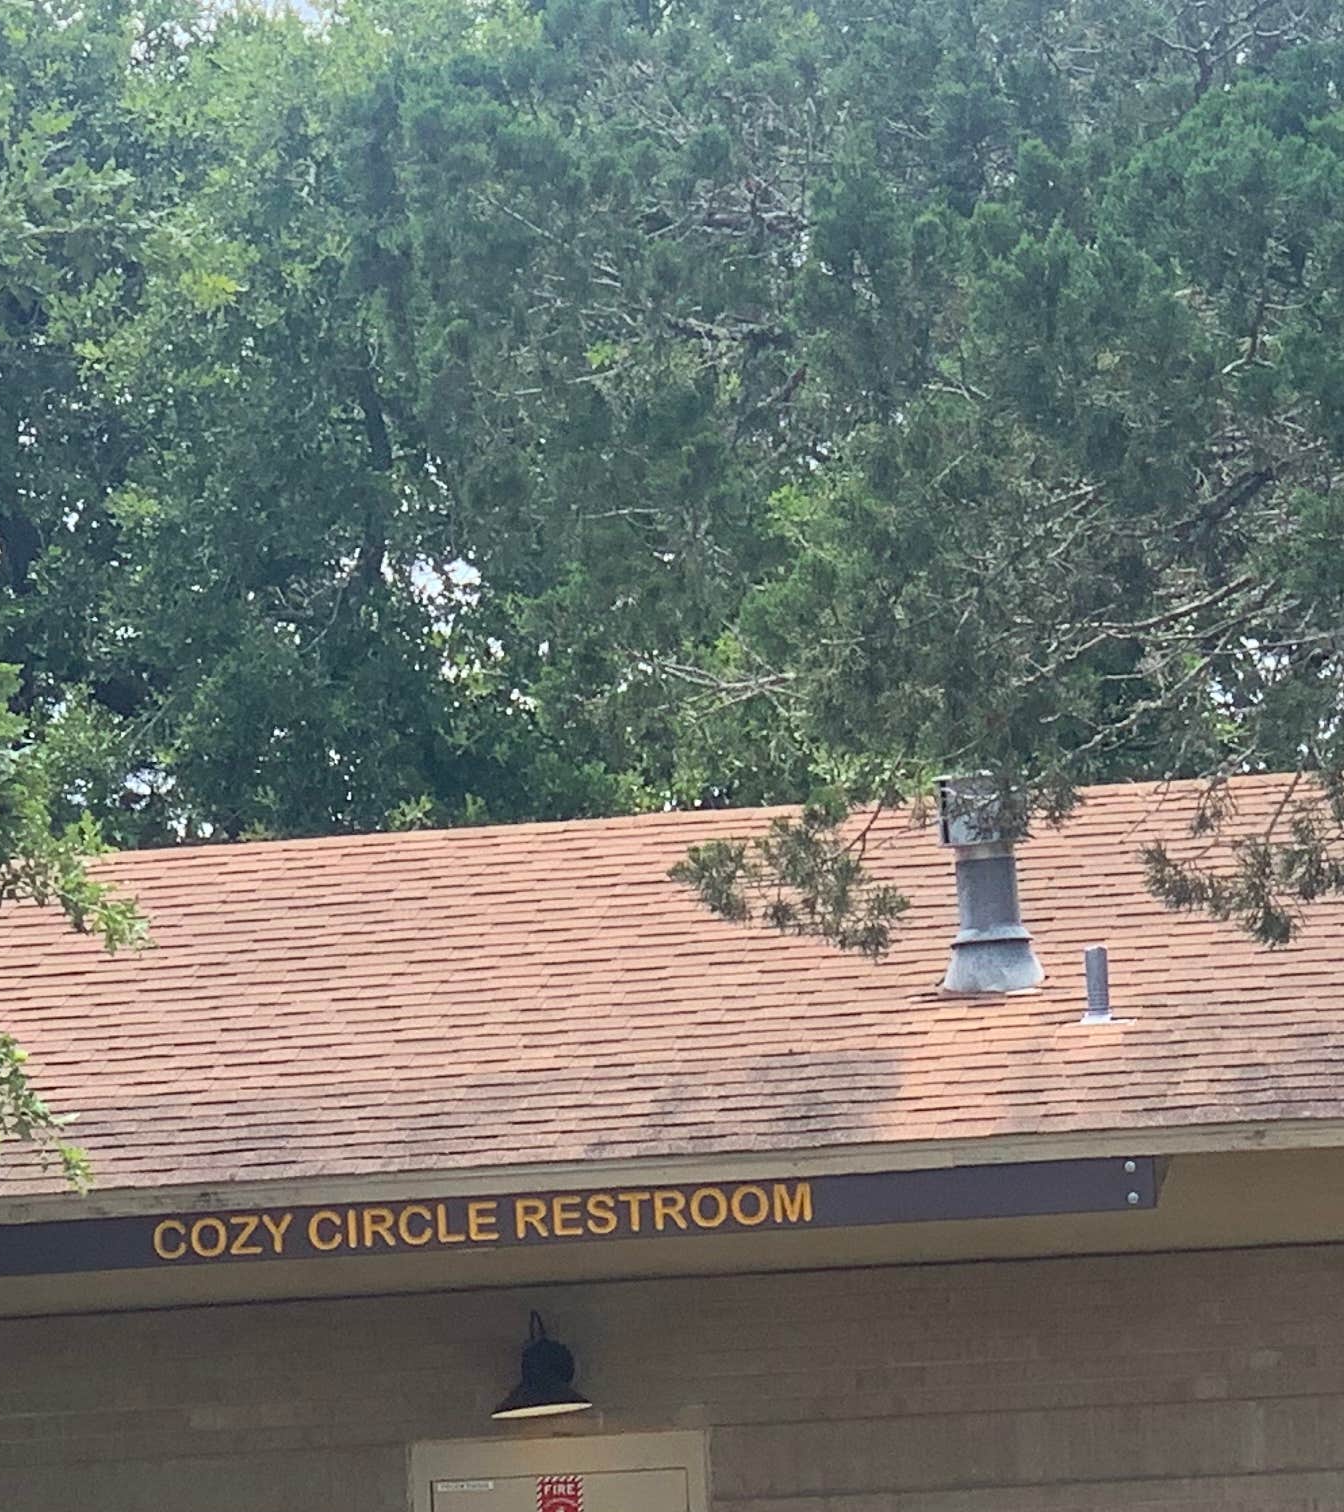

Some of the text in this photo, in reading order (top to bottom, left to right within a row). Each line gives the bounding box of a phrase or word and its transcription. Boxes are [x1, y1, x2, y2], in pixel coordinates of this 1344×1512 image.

[153, 1182, 814, 1260] COZY CIRCLE RESTROOM
[543, 1483, 576, 1496] FIRE
